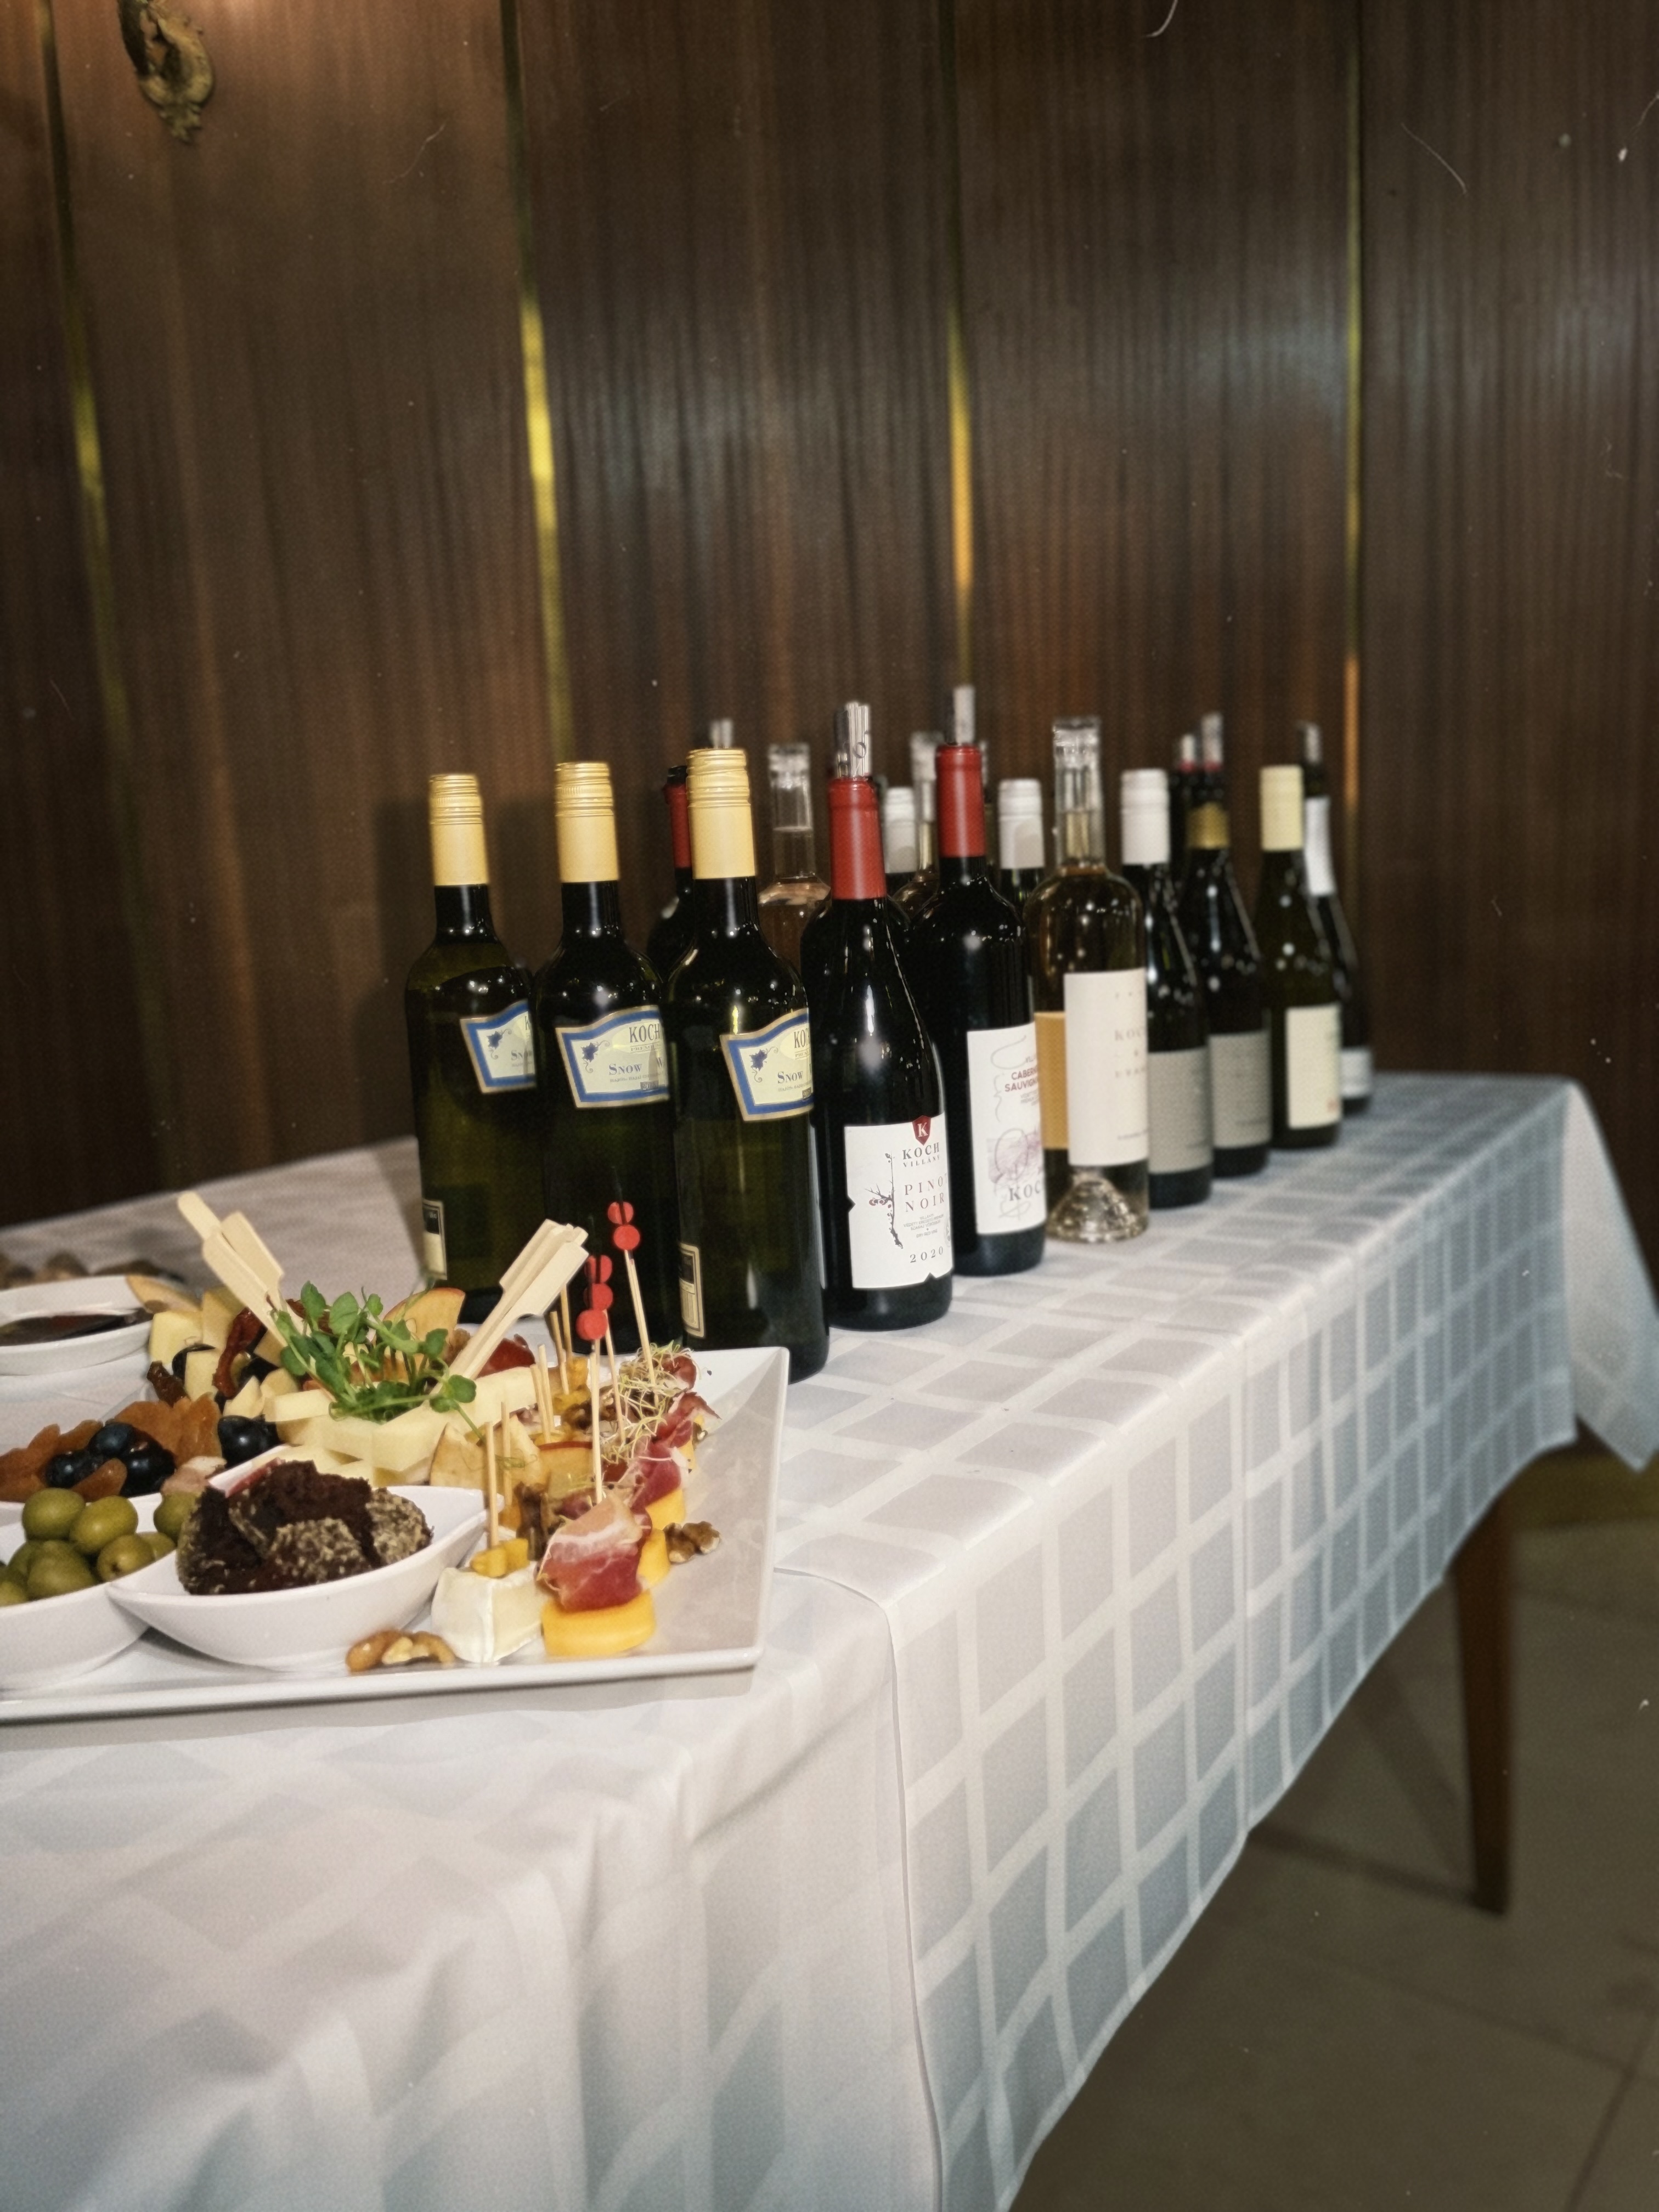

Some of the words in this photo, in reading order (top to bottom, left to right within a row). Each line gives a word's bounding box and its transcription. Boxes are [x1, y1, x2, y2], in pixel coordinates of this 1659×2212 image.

[629, 1023, 661, 1043] KOCH
[1005, 1077, 1037, 1092] SAUVIGN
[917, 1122, 928, 1137] K
[902, 1142, 939, 1160] KOCH
[1009, 1180, 1041, 1201] KOC
[905, 1192, 944, 1212] NOIR
[910, 1246, 944, 1263] 2020
